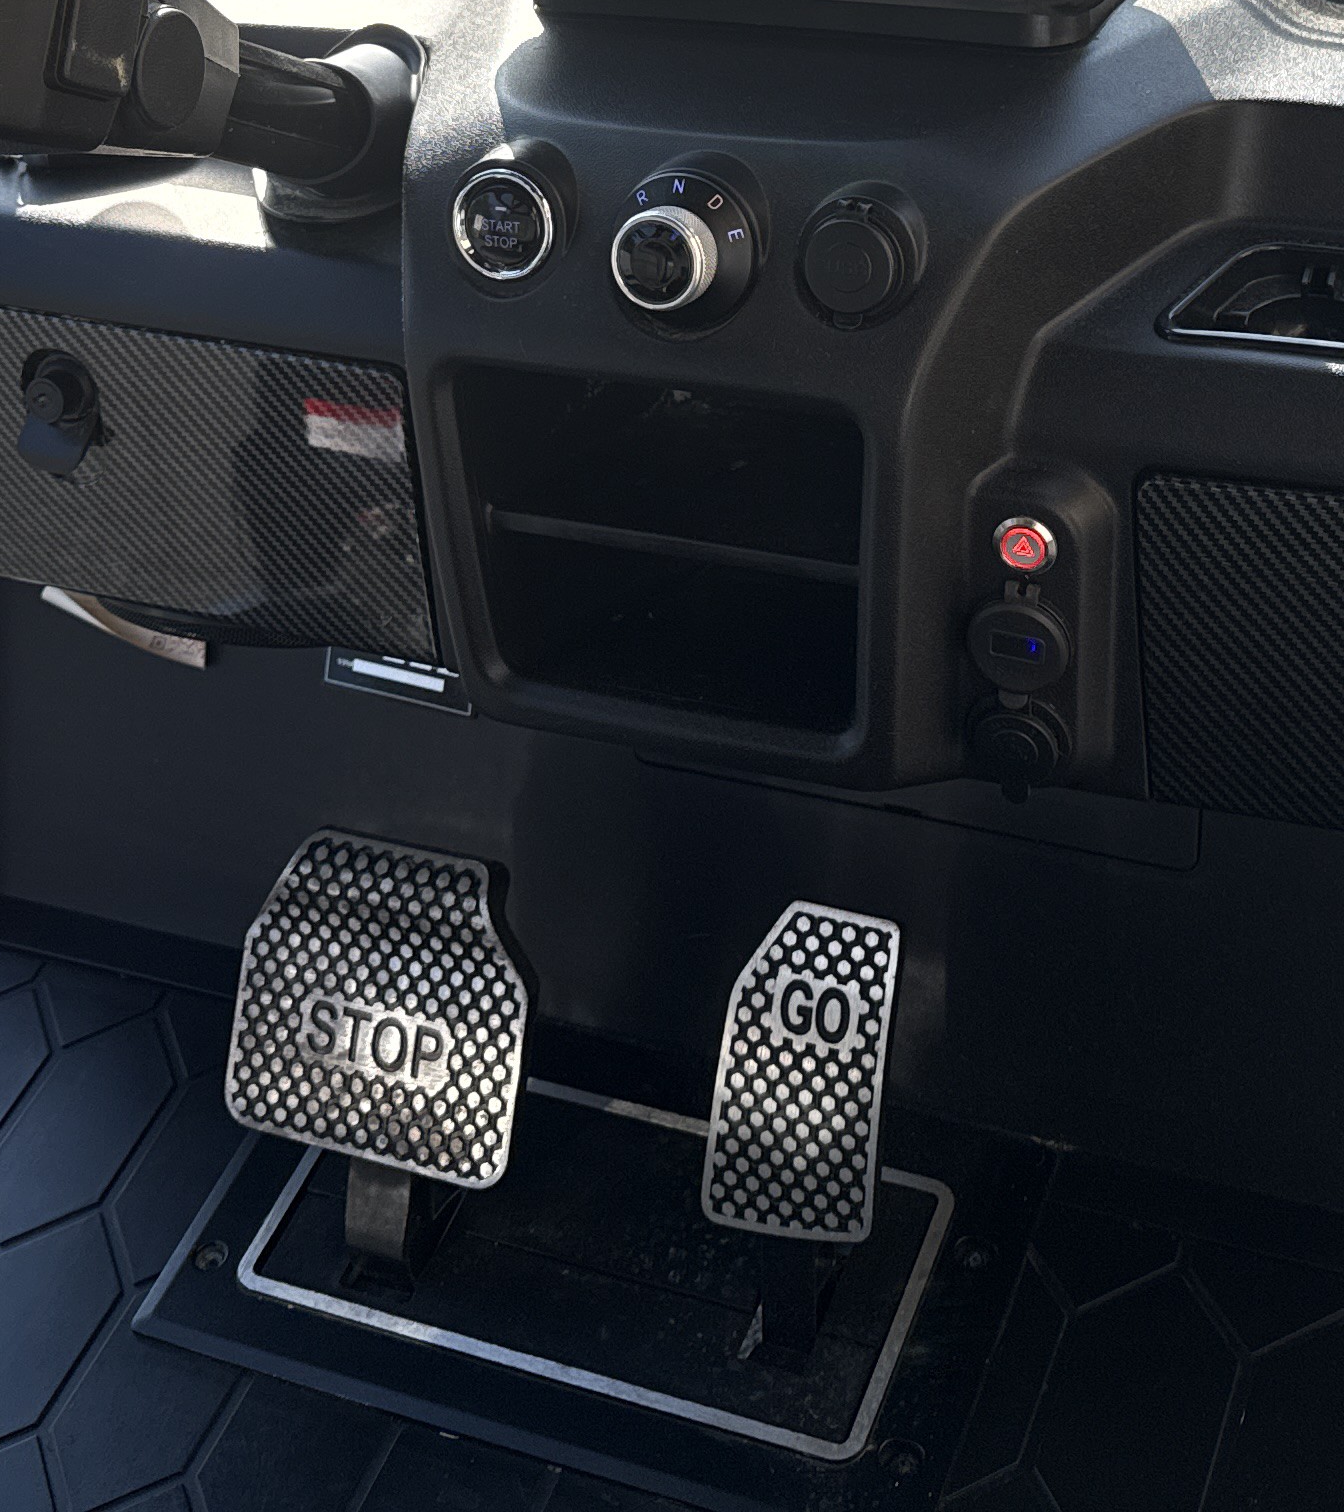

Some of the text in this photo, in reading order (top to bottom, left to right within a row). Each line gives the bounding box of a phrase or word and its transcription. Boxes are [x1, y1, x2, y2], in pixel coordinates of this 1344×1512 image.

[481, 218, 521, 234] START
[484, 234, 518, 249] STOP
[635, 178, 745, 243] R N D E
[305, 999, 445, 1082] STOP
[779, 978, 851, 1046] GO
